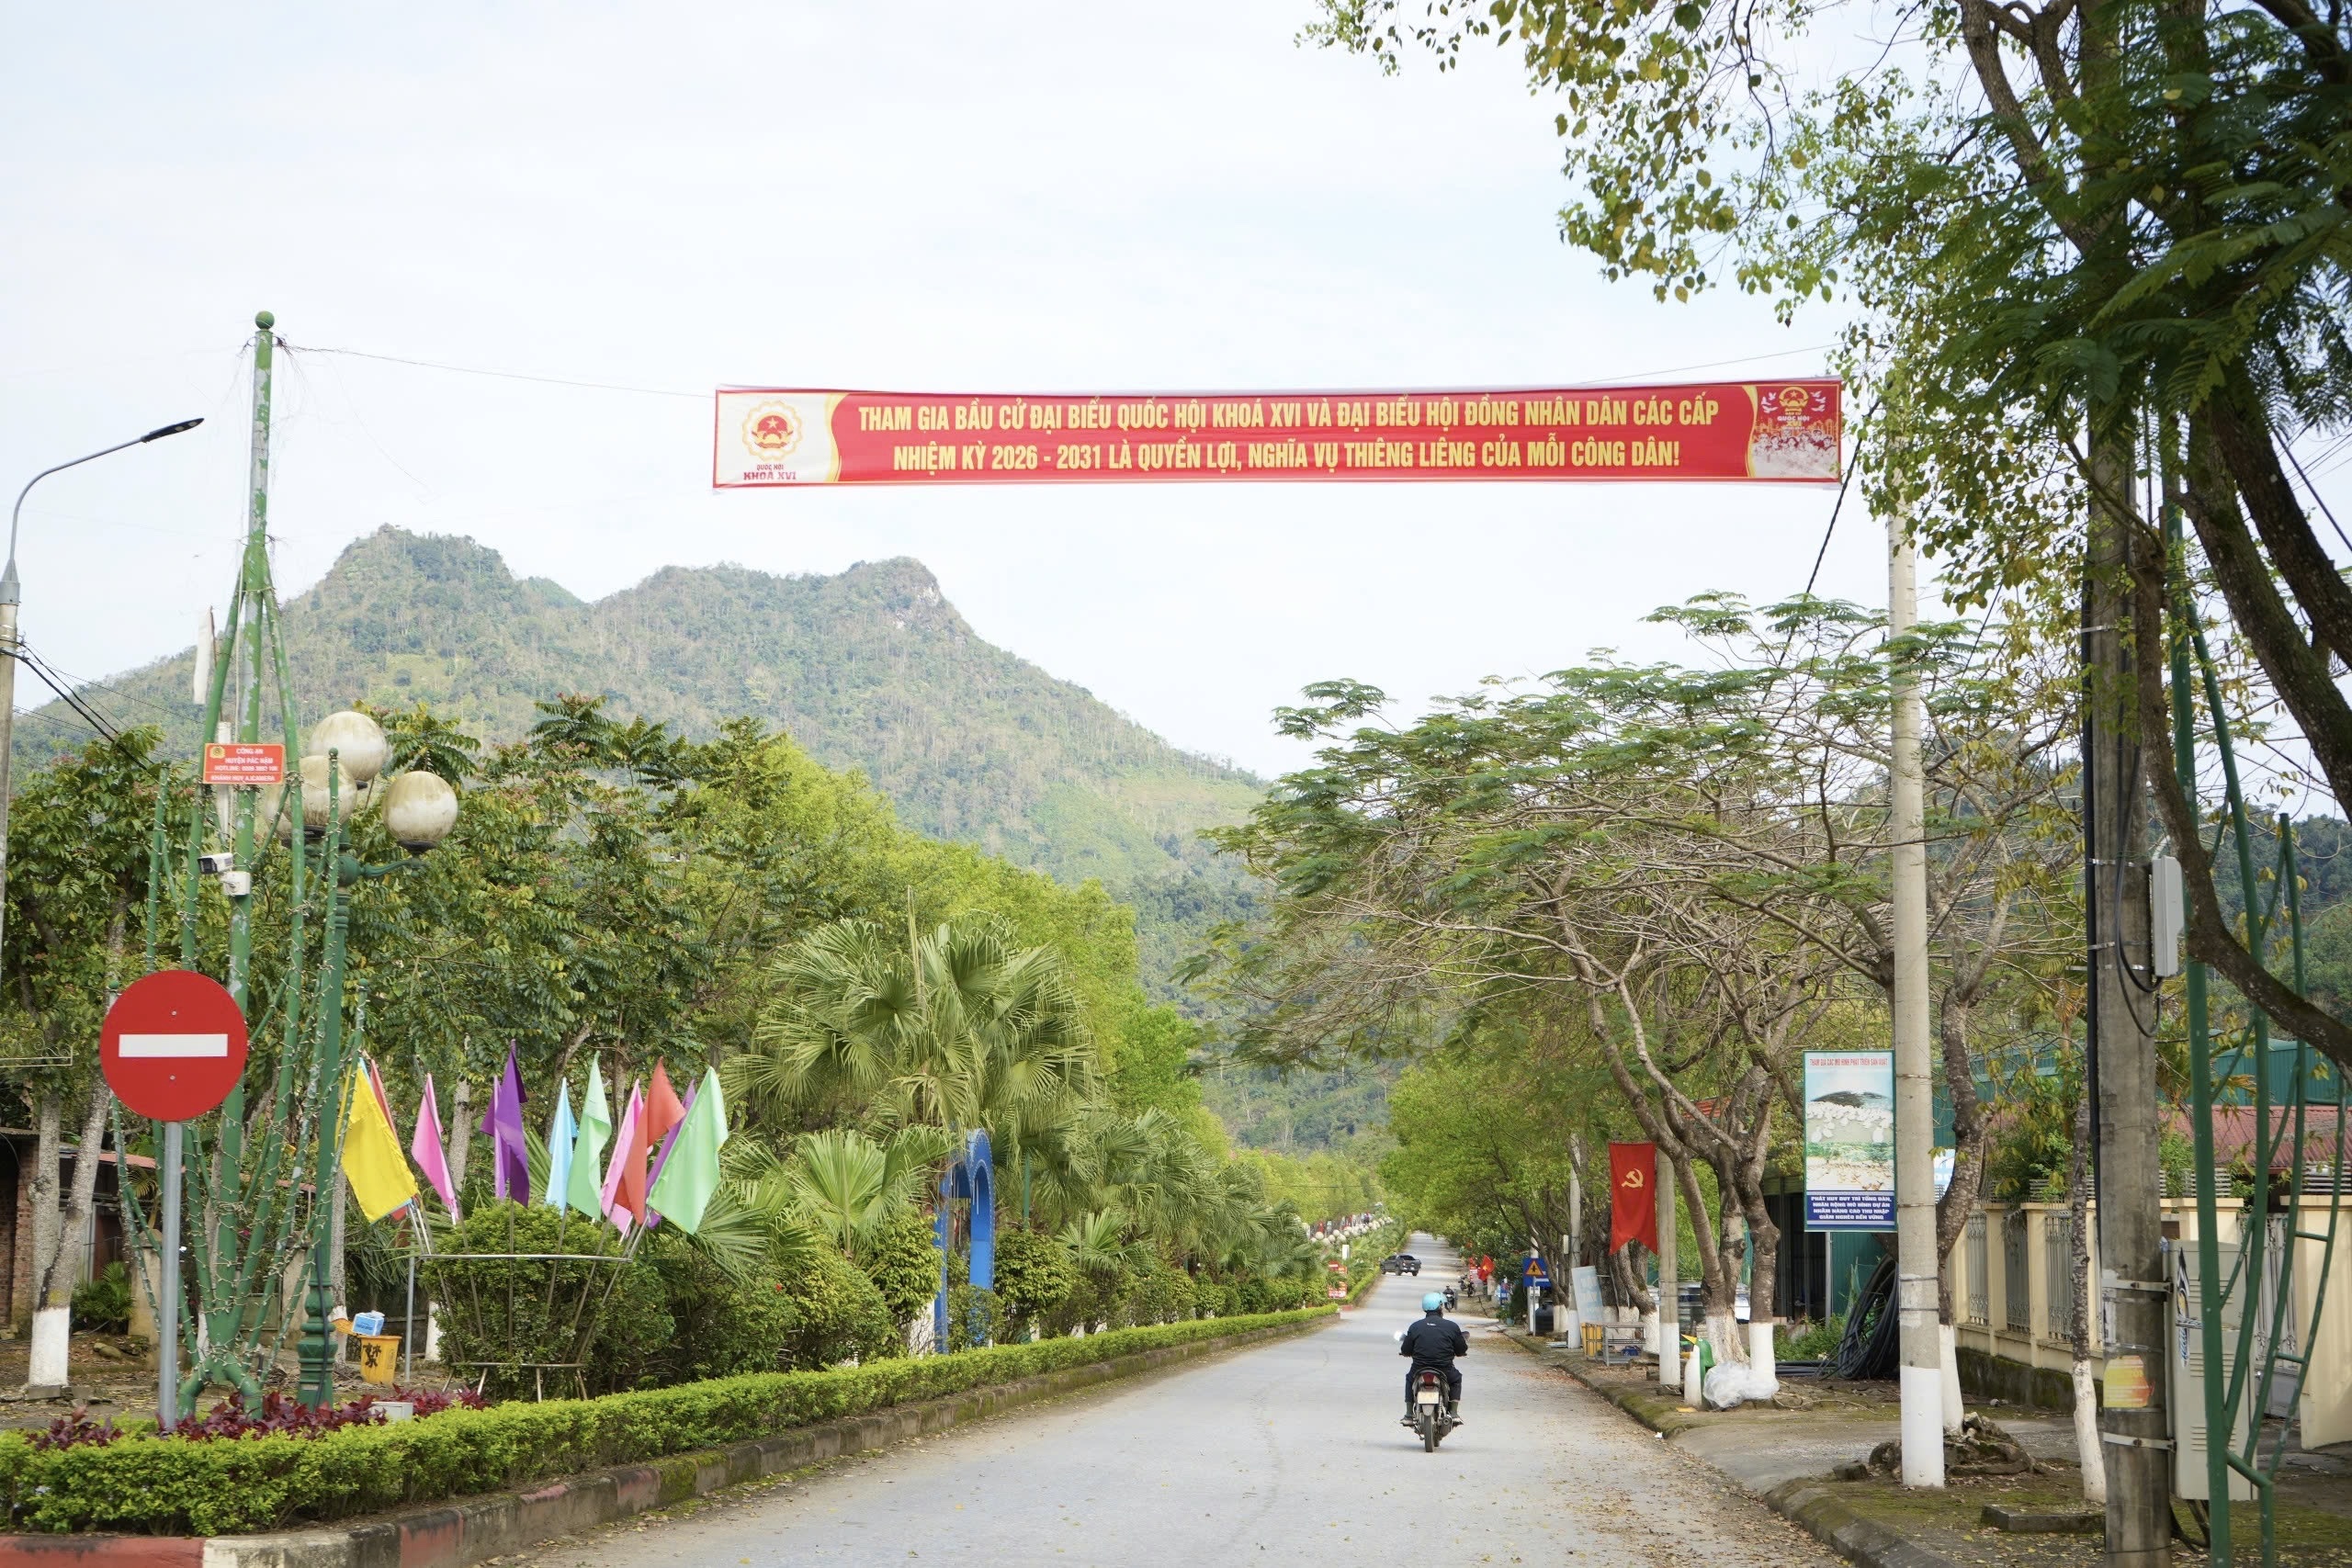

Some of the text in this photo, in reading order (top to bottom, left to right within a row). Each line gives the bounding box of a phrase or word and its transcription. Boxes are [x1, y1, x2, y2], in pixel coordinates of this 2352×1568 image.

[858, 391, 1719, 434] THAM GIA BẦU CỬ ĐẠI BIỂU QUỐC HỘI KHOÁ XVI VÀ ĐẠI BIỂU HỘI ĐỒNG NHÂN DÂN CÁC CẤP
[893, 441, 956, 476] NHIỆM
[962, 441, 987, 470] KỲ
[991, 445, 1038, 470] 2026
[1057, 445, 1101, 470] 2031
[1109, 439, 1132, 468] LÀ
[1137, 435, 1201, 471] QUYỀN
[1207, 441, 1242, 474] LỢI,
[1248, 438, 1308, 468] NGHĨA
[1314, 443, 1338, 473] VỤ
[1344, 437, 1413, 468] THIÊNG
[1419, 437, 1476, 467] LIÊNG
[1481, 434, 1521, 467] CỦA
[1527, 433, 1566, 467] MỖI
[1571, 435, 1625, 467] CÔNG
[1632, 435, 1679, 467] DÂN!
